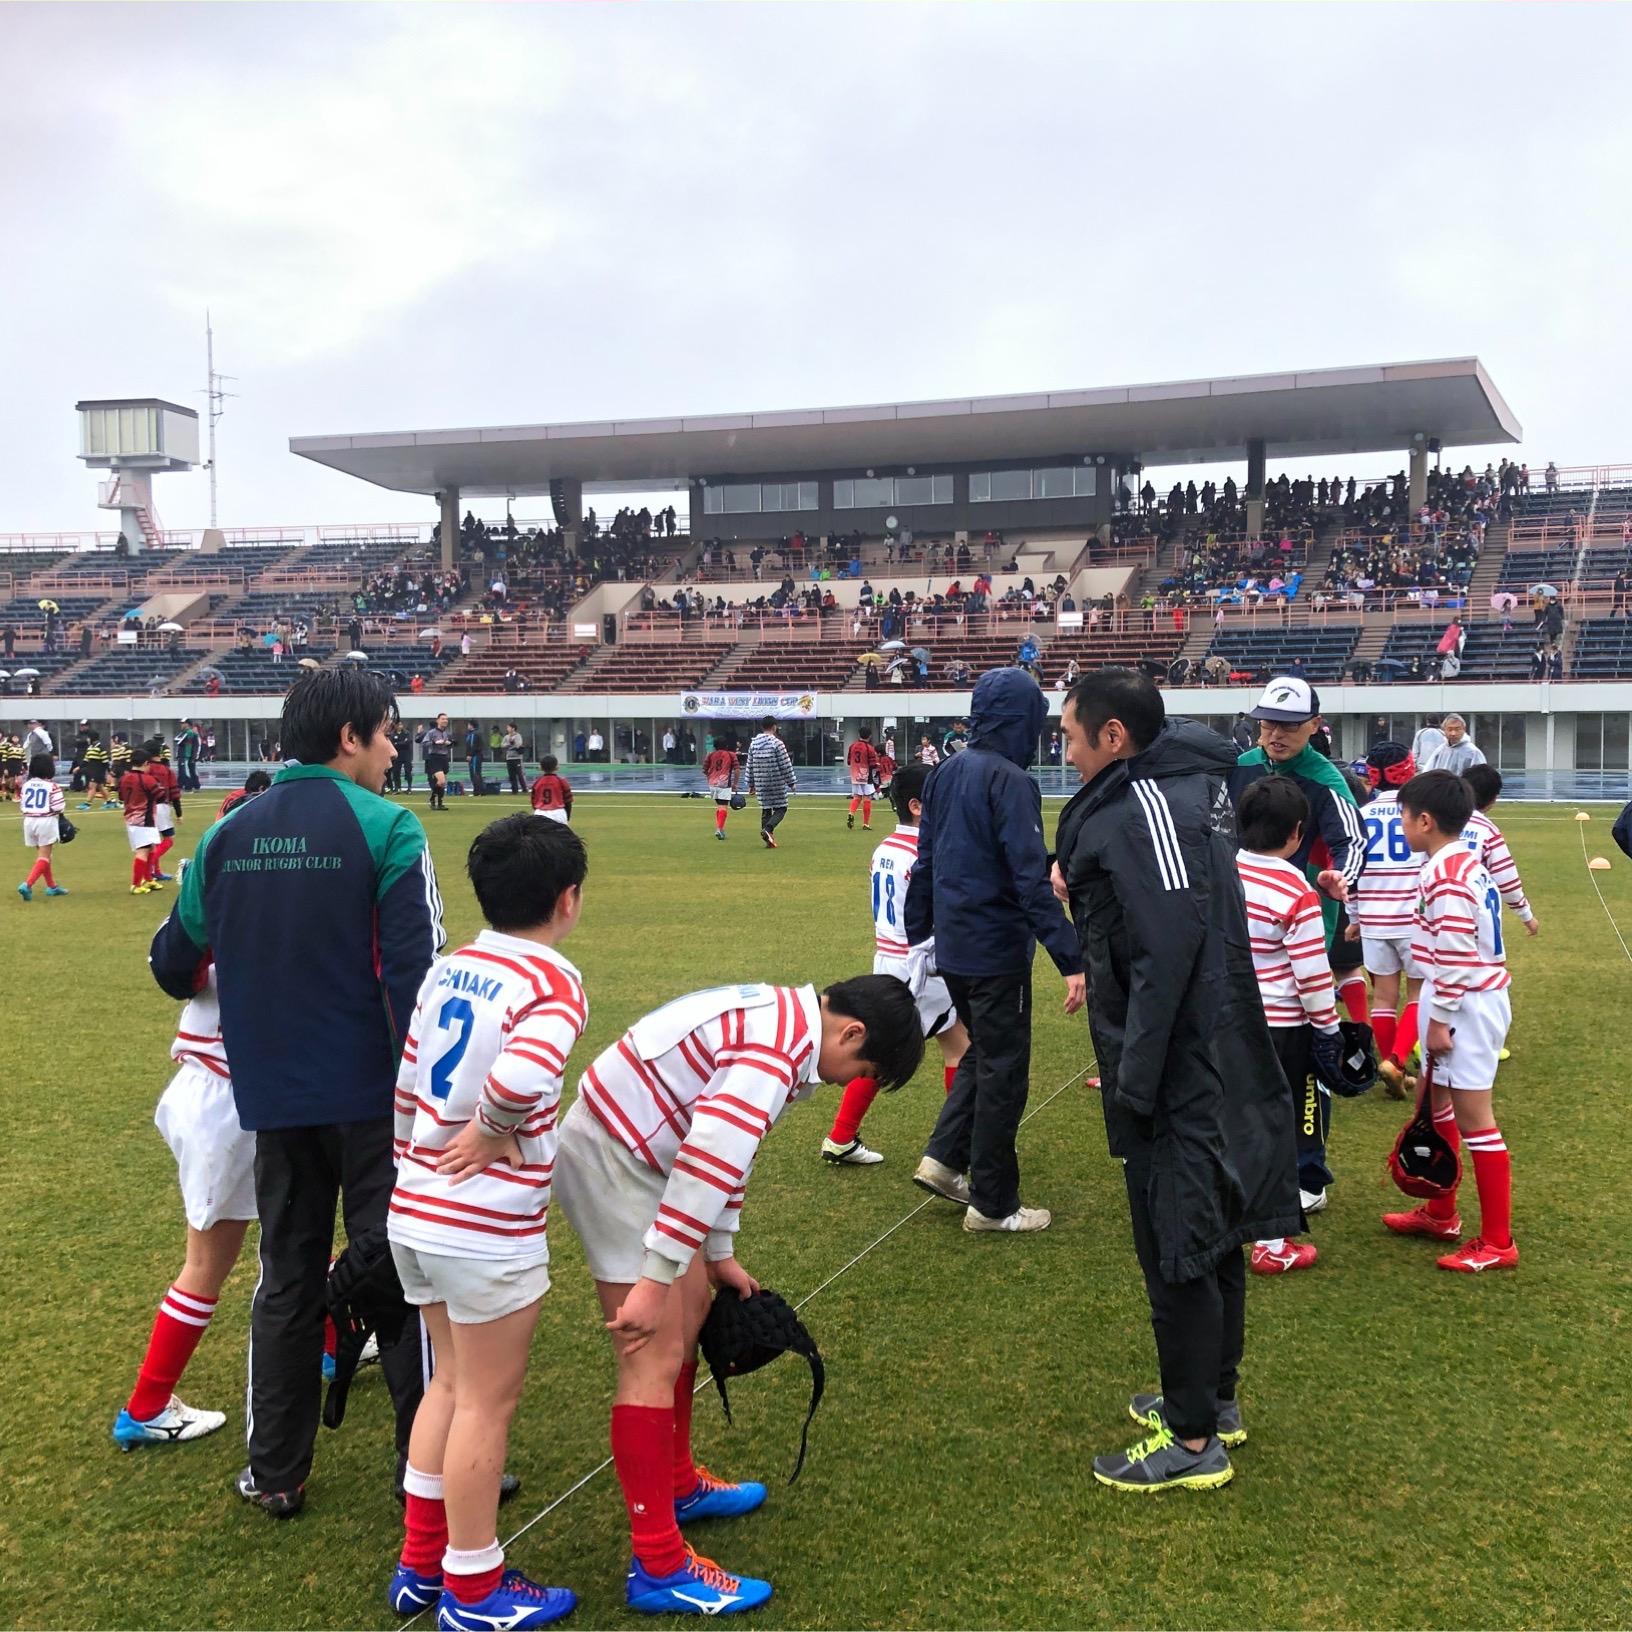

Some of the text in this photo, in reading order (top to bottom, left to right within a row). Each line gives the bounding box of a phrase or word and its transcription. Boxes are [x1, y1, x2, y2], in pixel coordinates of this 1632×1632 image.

[25, 787, 48, 808] 20
[542, 788, 553, 805] 9
[252, 836, 307, 855] IKOMA
[1365, 817, 1411, 862] 26
[222, 856, 342, 873] JUNIOR RUGBY CLUB
[873, 871, 896, 926] 18
[431, 996, 475, 1106] 2
[1303, 1072, 1317, 1136] umbro
